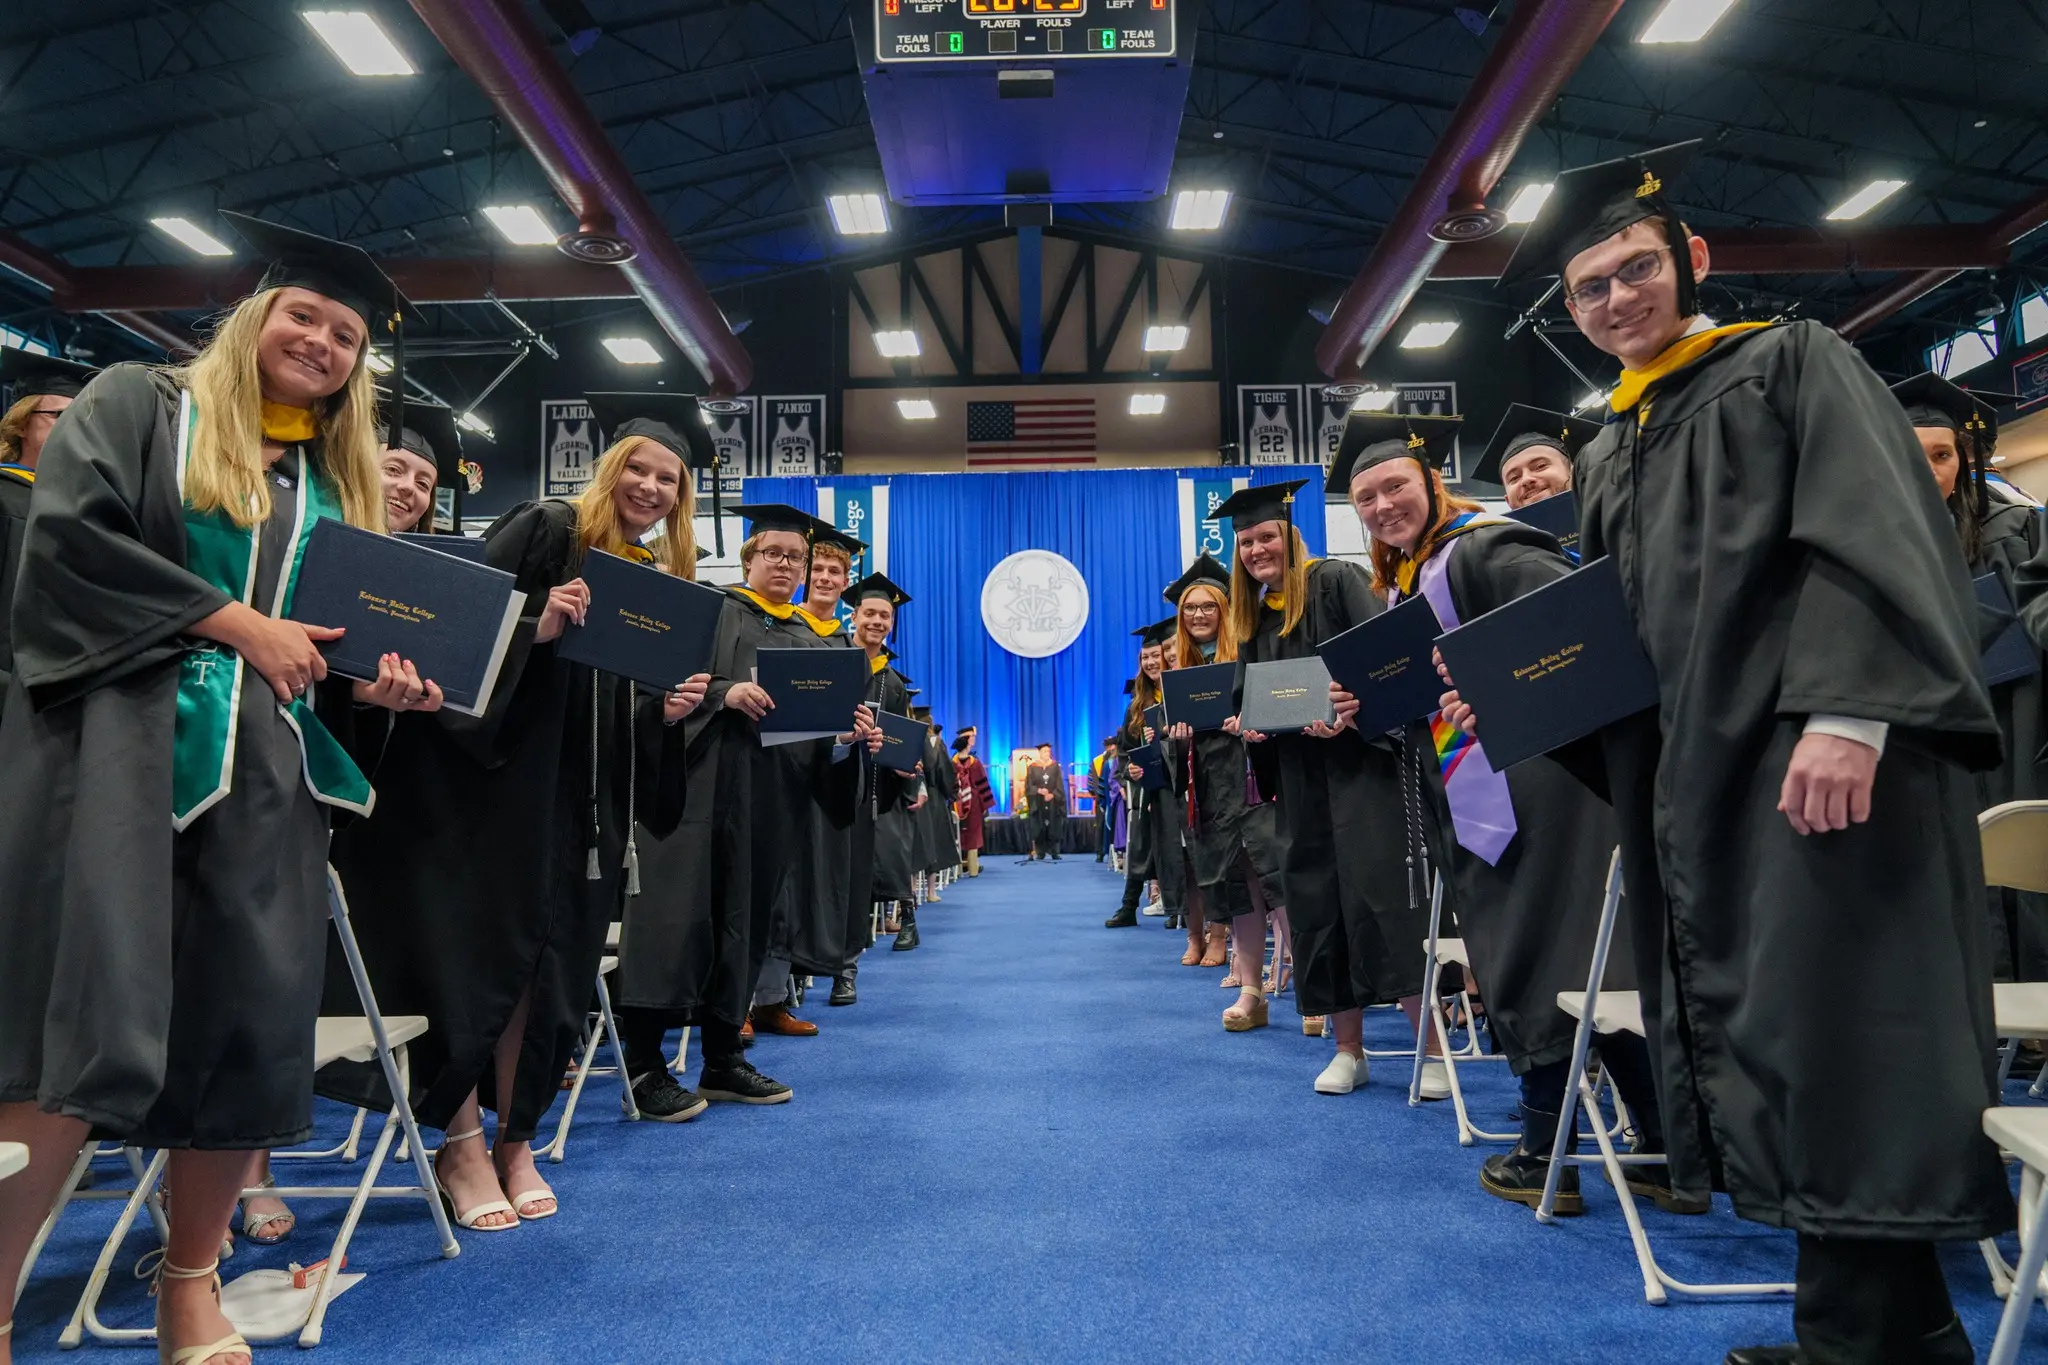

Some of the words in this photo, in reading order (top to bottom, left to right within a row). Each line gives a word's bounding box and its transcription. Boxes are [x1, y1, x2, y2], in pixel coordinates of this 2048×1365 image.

[915, 4, 943, 13] LEFT
[1106, 0, 1134, 9] LEFT
[980, 19, 1021, 28] PLAYER
[1036, 18, 1072, 27] FOULS
[897, 35, 929, 43] TEAM
[1102, 30, 1114, 49] 0
[1122, 30, 1154, 39] TEAM
[950, 33, 962, 52] 0
[1120, 40, 1156, 48] FOULS
[895, 45, 931, 53] FOULS
[1253, 392, 1287, 403] TIGHE
[1403, 390, 1446, 401] HOOVER
[777, 402, 812, 414] PANKO
[1253, 424, 1289, 437] LEBANON
[555, 441, 590, 452] LEBANON
[713, 437, 743, 449] EBANON
[776, 436, 811, 448] LEBANON
[1260, 435, 1284, 453] 22
[1328, 434, 1340, 452] 2
[565, 451, 581, 468] 11
[782, 446, 806, 464] 33
[1257, 455, 1287, 463] VALLEY
[557, 470, 587, 479] VALLEY
[778, 466, 809, 474] VALLEY
[359, 590, 387, 604] Lebanon
[388, 600, 410, 613] Valley
[412, 606, 436, 620] College
[655, 620, 671, 631] College
[1512, 663, 1539, 680] Lebanon
[1540, 654, 1561, 667] Valley
[1561, 643, 1584, 656] College
[191, 660, 216, 686] T
